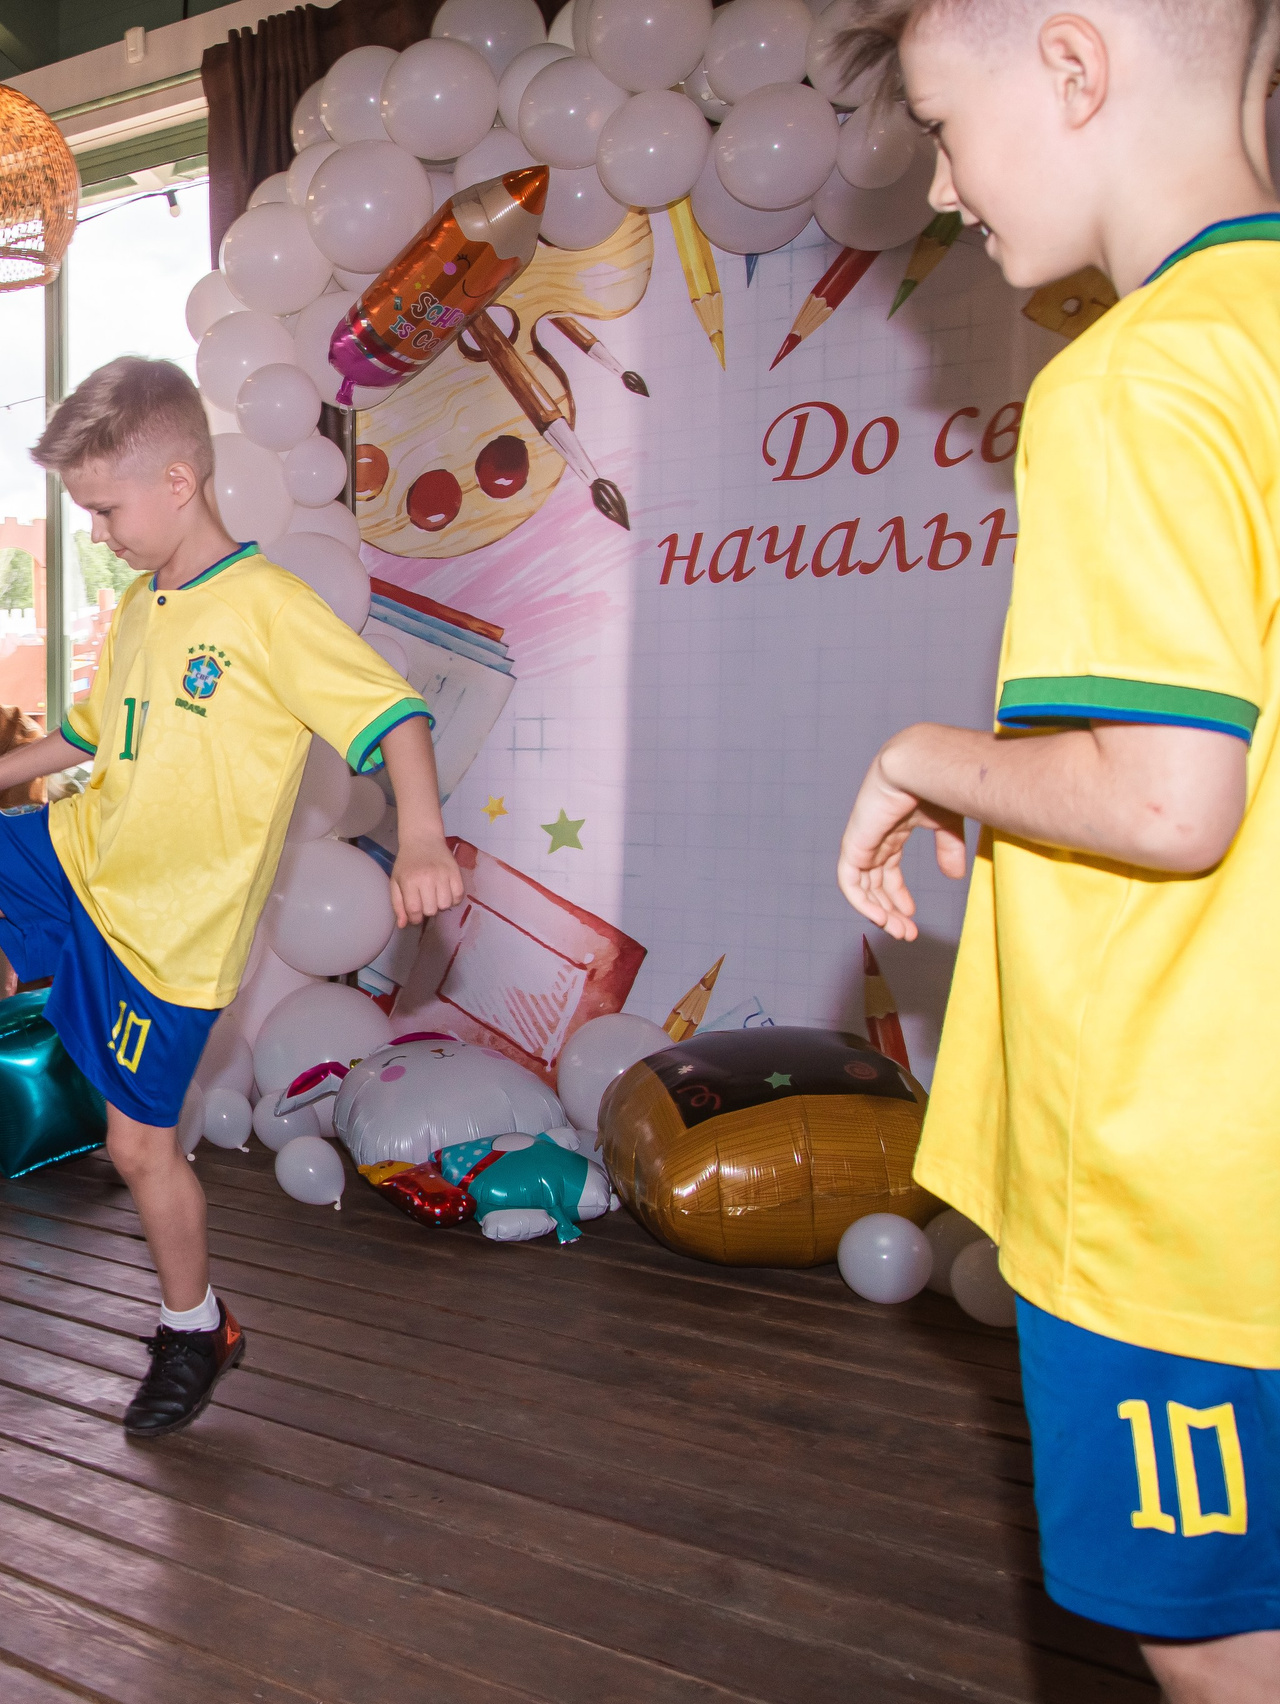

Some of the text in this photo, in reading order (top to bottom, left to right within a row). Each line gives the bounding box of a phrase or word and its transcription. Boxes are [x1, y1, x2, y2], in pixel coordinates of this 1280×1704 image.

[389, 315, 416, 339] IS
[762, 401, 900, 482] До
[107, 1000, 151, 1074] 10
[1117, 1399, 1248, 1537] 10
